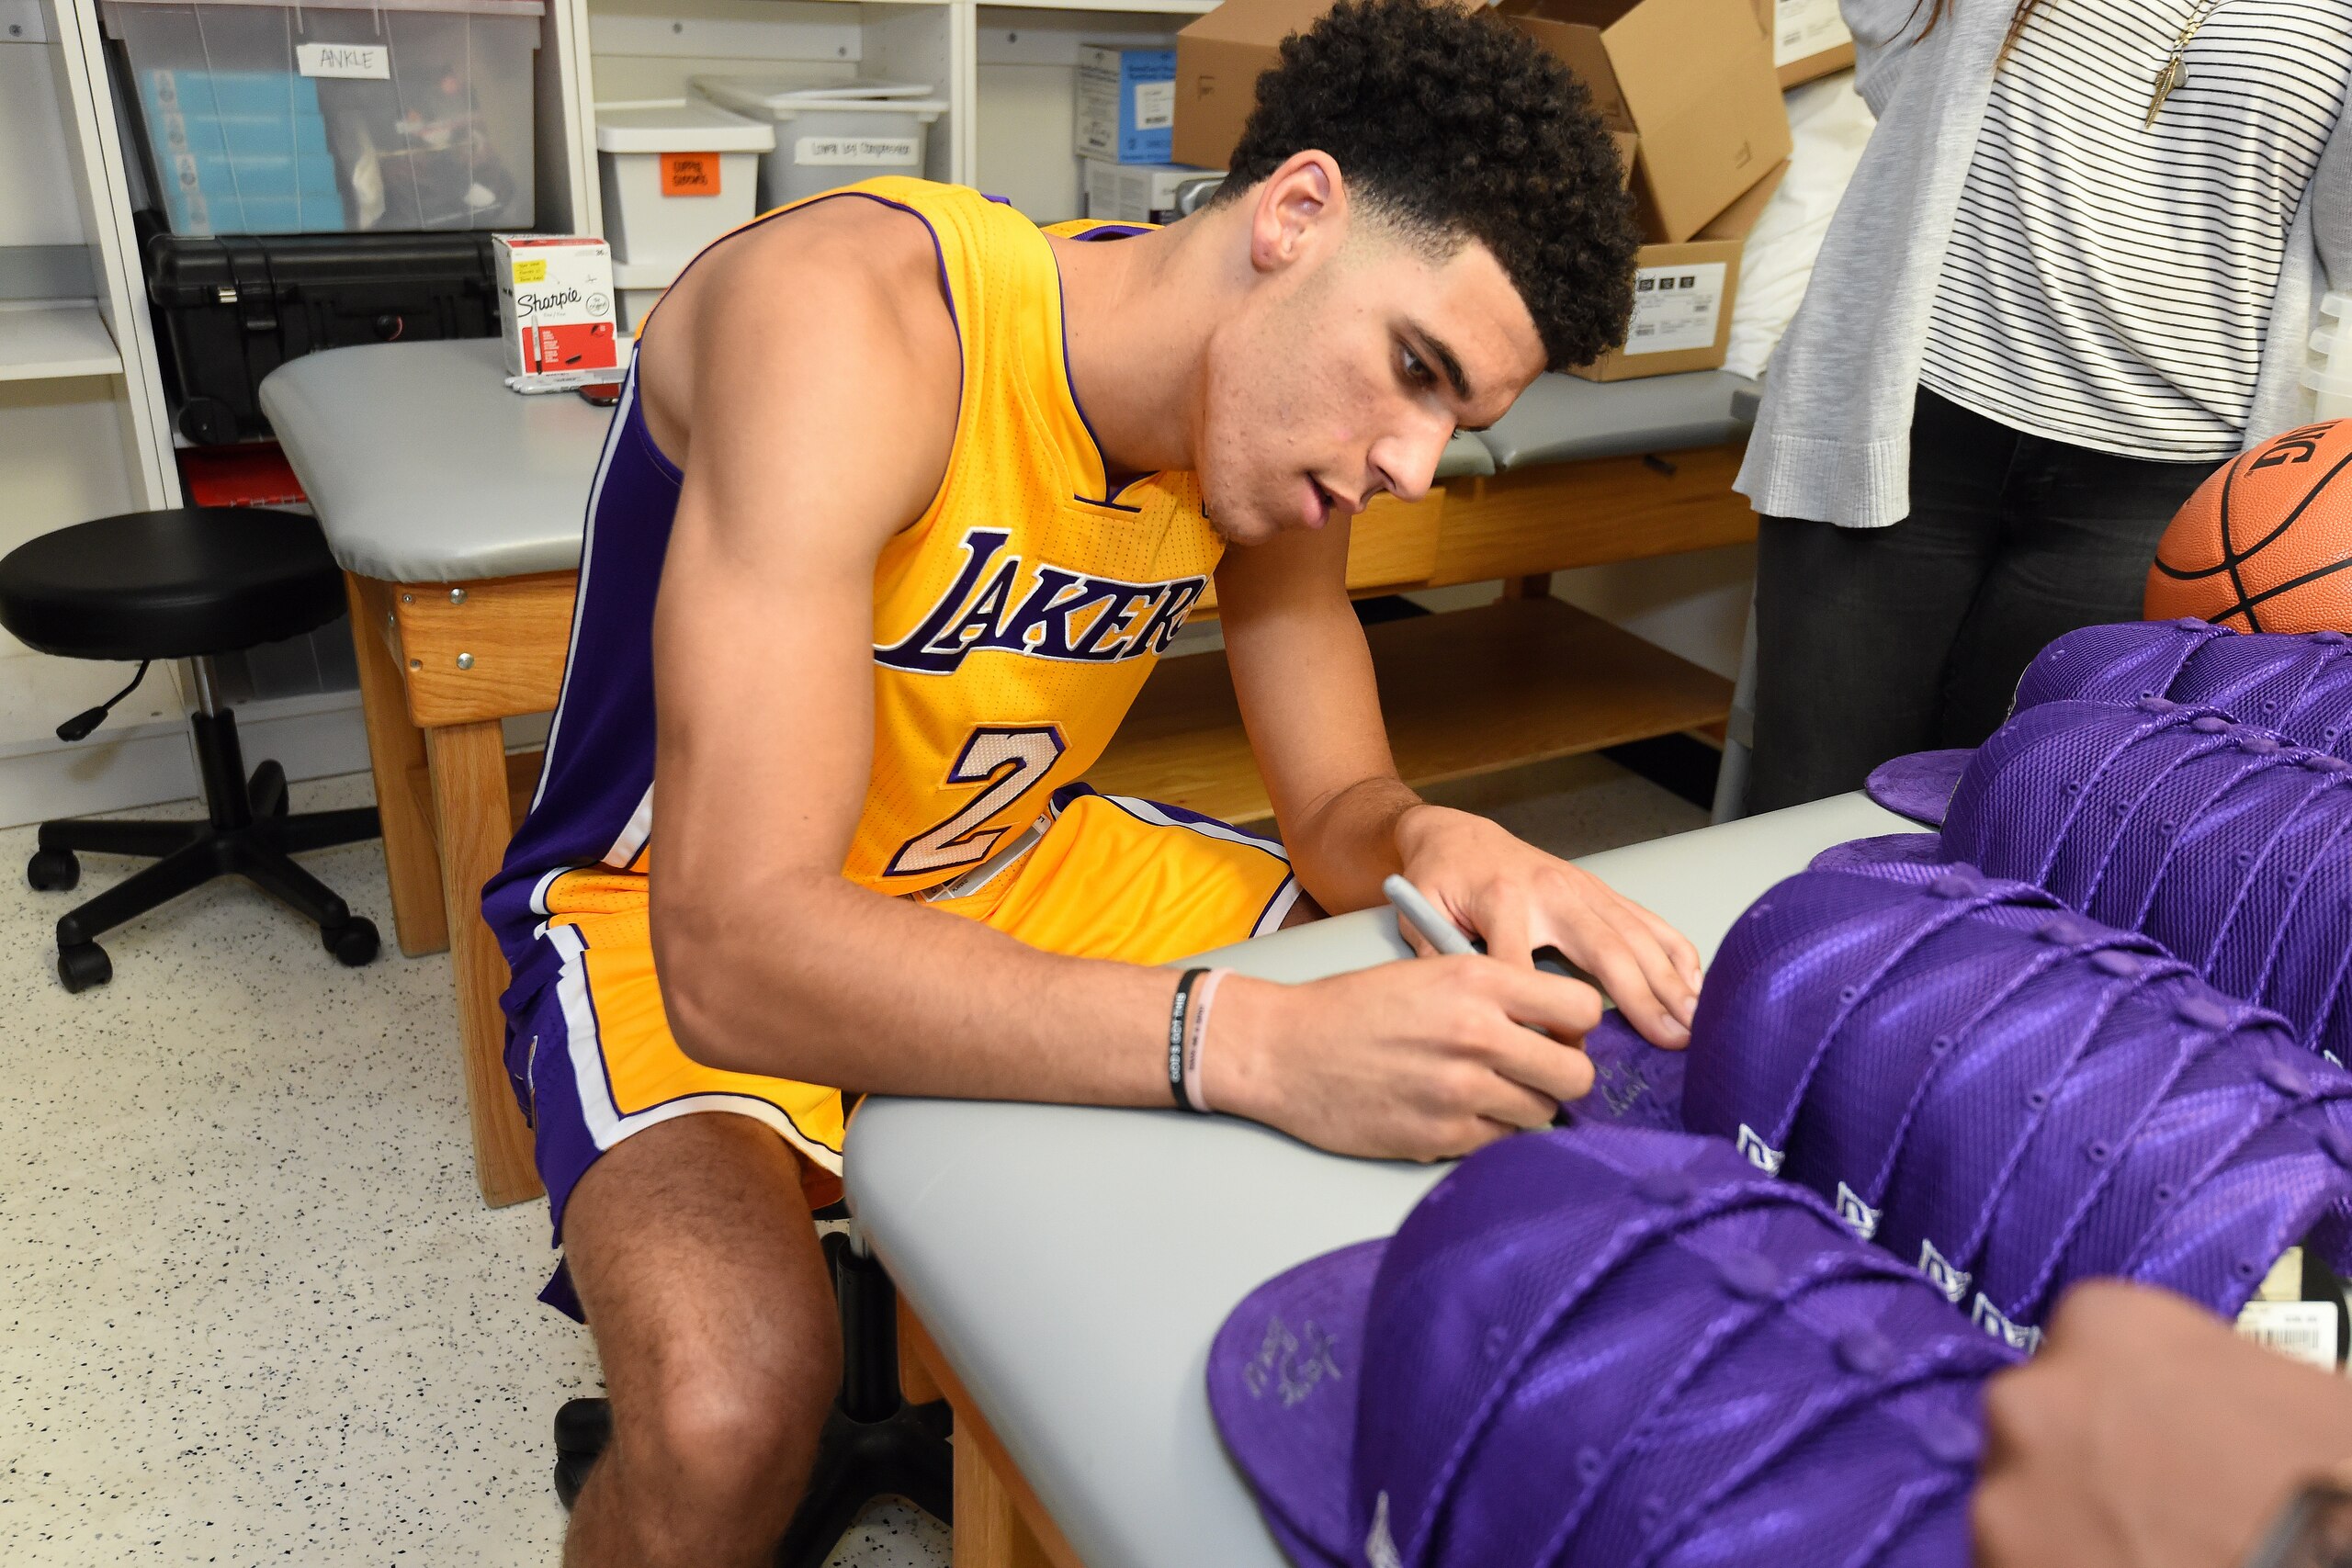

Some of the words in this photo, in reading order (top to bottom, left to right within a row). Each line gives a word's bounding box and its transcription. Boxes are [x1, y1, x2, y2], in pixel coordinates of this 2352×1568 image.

[320, 49, 374, 69] ANKLE
[517, 288, 582, 318] Sharpie
[878, 723, 1071, 879] 2
